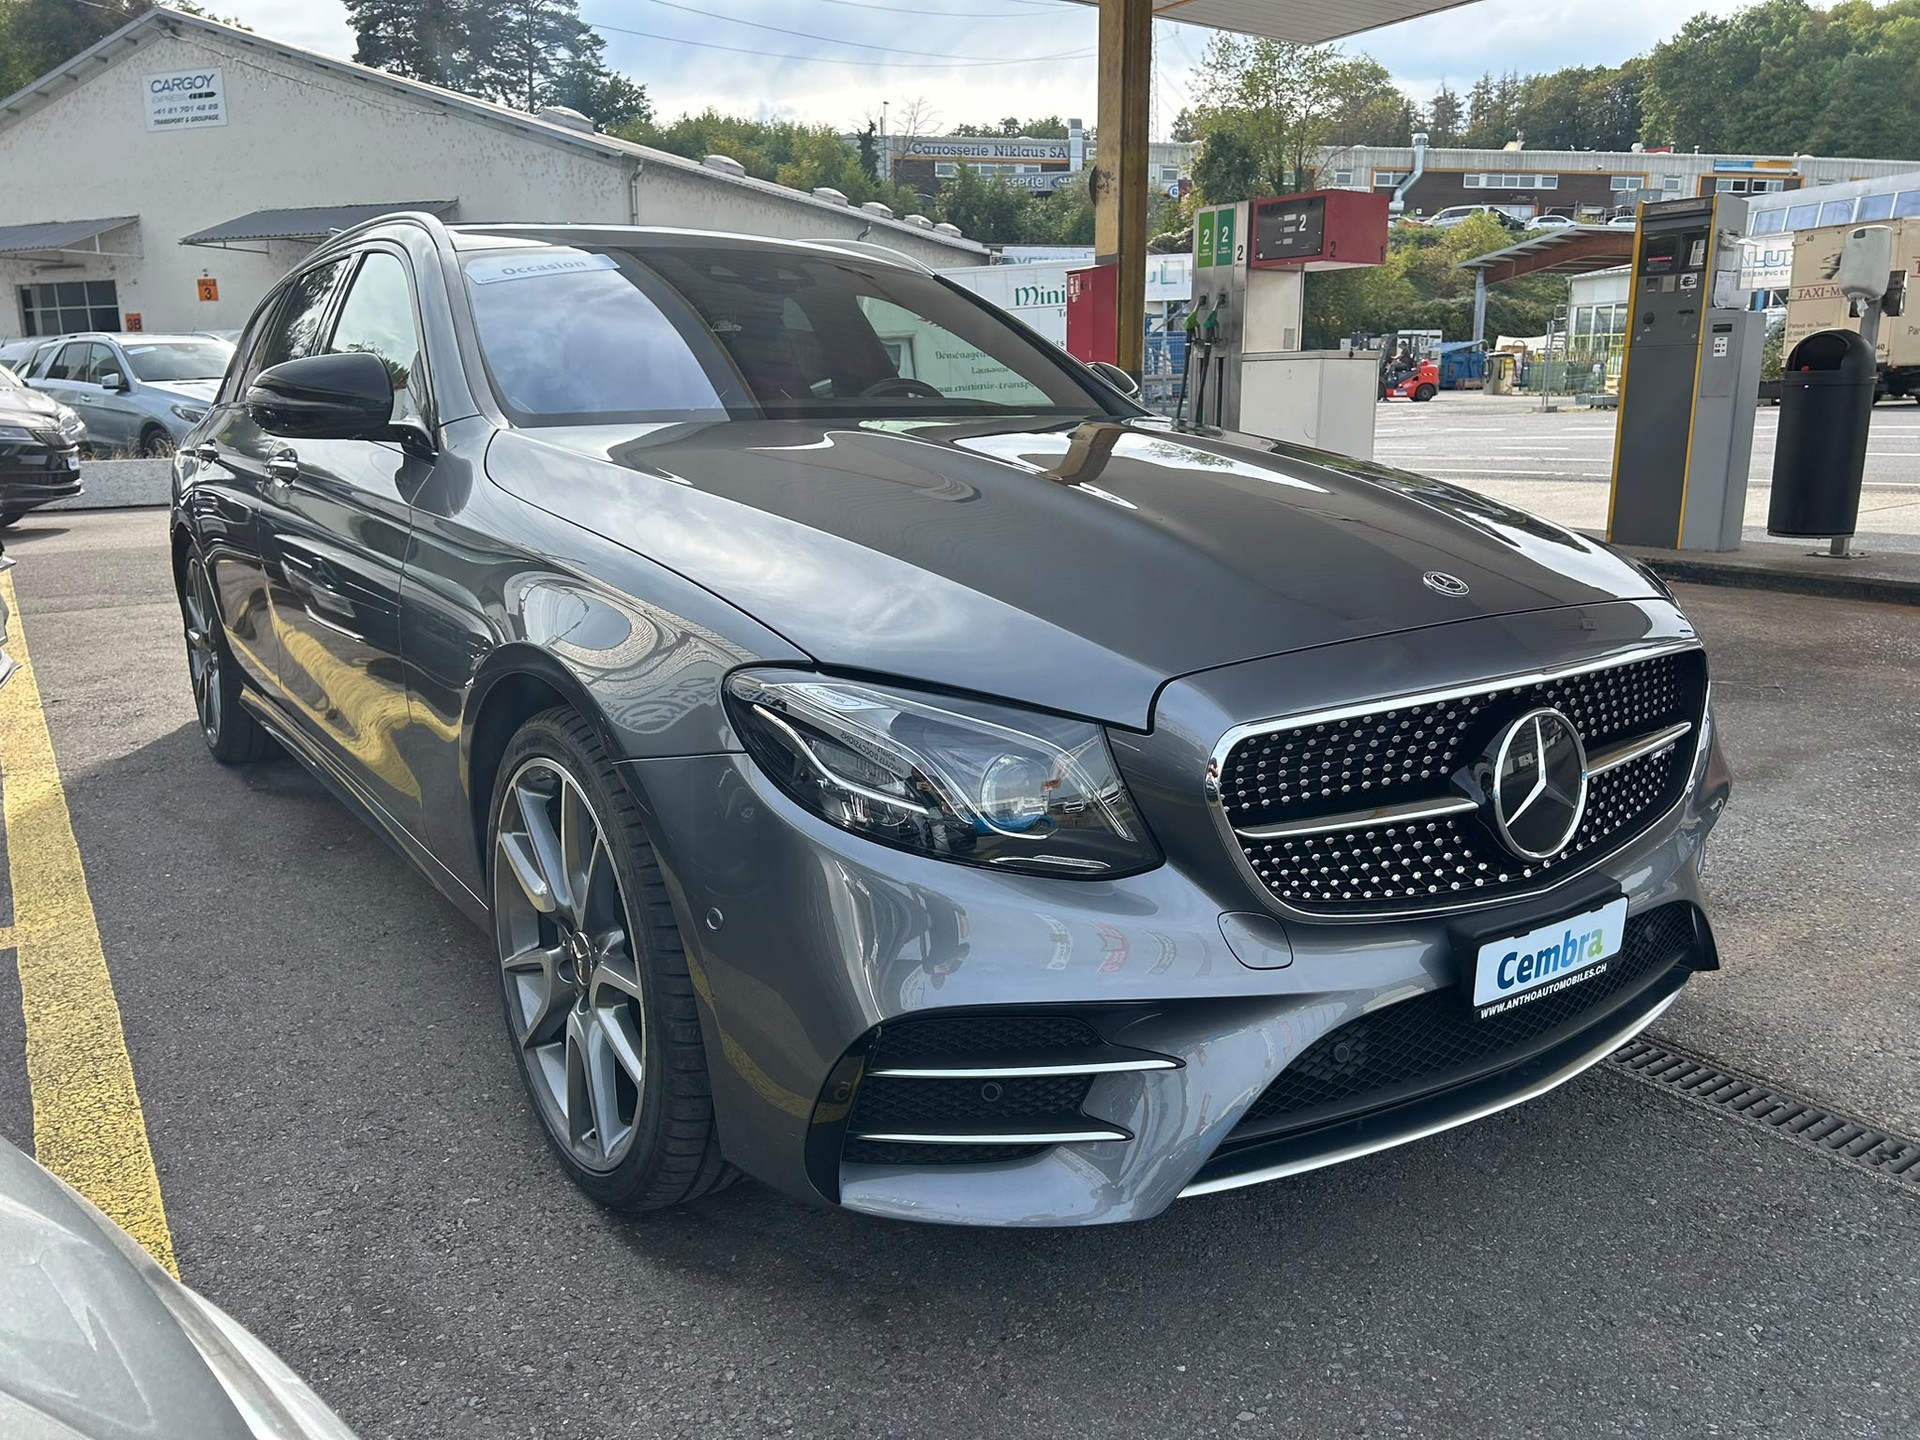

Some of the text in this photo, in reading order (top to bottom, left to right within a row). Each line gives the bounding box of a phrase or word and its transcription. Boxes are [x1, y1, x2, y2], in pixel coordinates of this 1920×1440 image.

[151, 74, 215, 93] CARGOY
[912, 143, 1067, 158] Carrosserie Niklaus SA
[1299, 213, 1307, 231] 2
[1203, 228, 1210, 245] 2
[1222, 226, 1229, 243] 2
[1237, 245, 1243, 261] 2
[1330, 241, 1337, 257] 2
[503, 261, 587, 275] Occasion
[1764, 269, 1779, 277] PVC
[204, 286, 212, 300] 3
[1496, 927, 1604, 990] Cembra
[1480, 963, 1608, 1019] WWW.ANTHOAUTOMOBILES.CH
